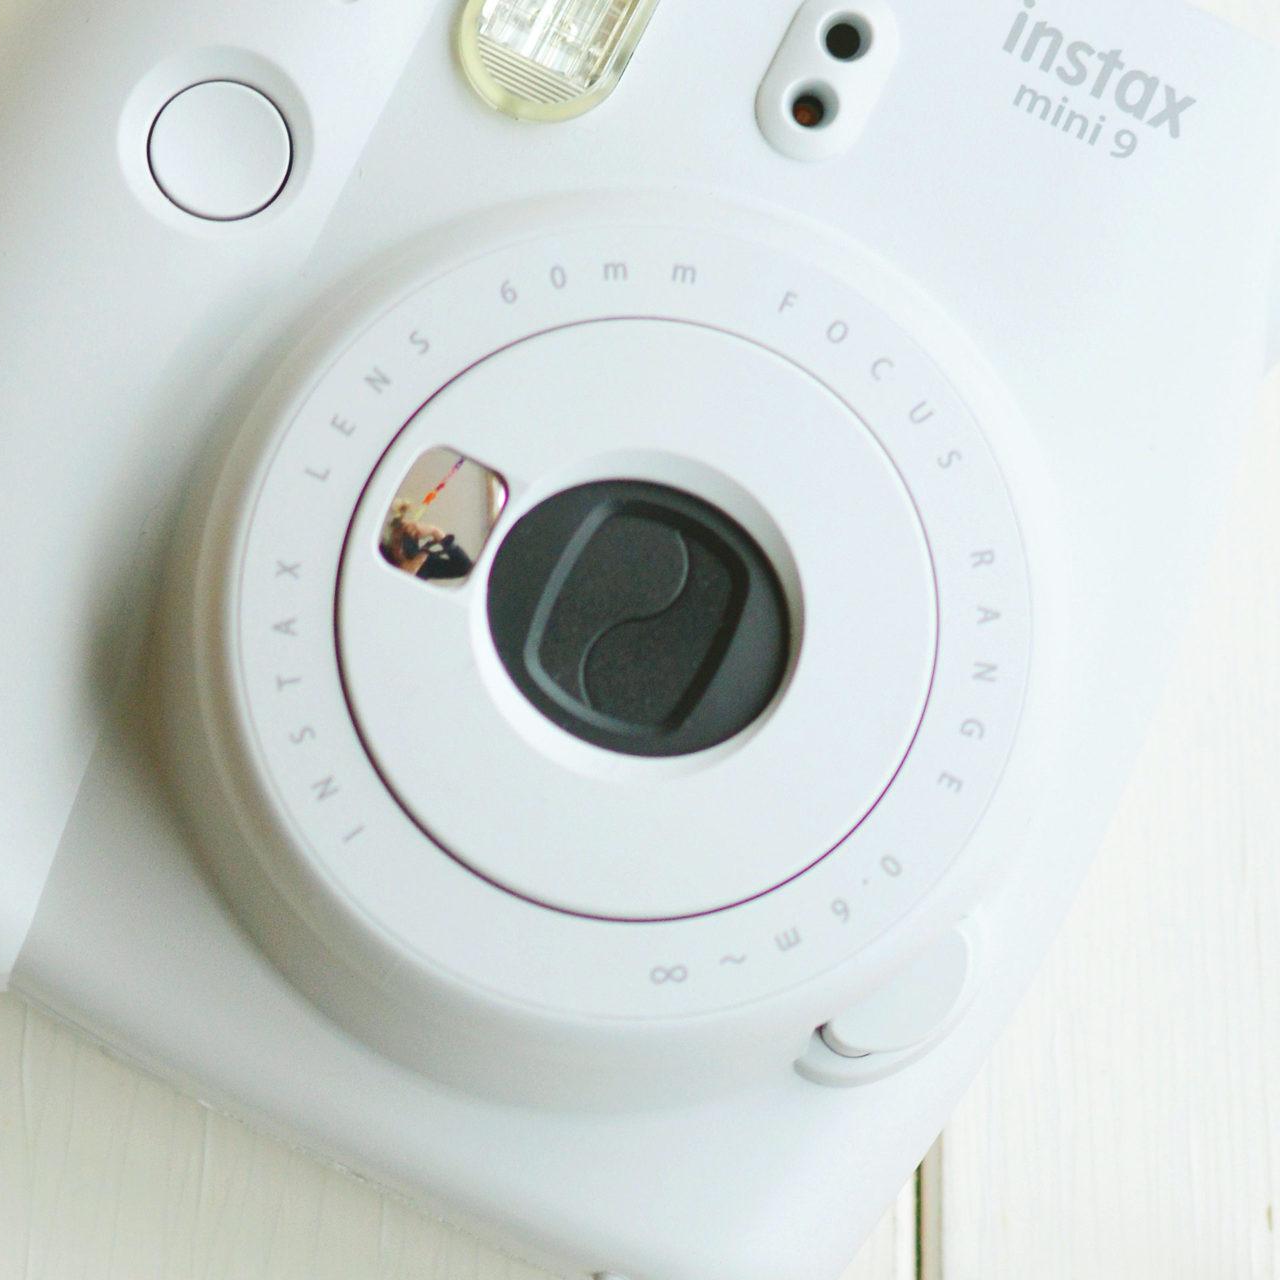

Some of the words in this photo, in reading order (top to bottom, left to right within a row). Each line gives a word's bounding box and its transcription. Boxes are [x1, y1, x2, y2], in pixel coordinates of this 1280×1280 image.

[1002, 0, 1197, 139] instax
[1013, 84, 1106, 146] mini
[1110, 129, 1137, 158] 9
[304, 330, 431, 482] LENS
[778, 290, 962, 469] FOCUS
[272, 560, 366, 844] INSTAX
[937, 549, 1002, 794] RANGE
